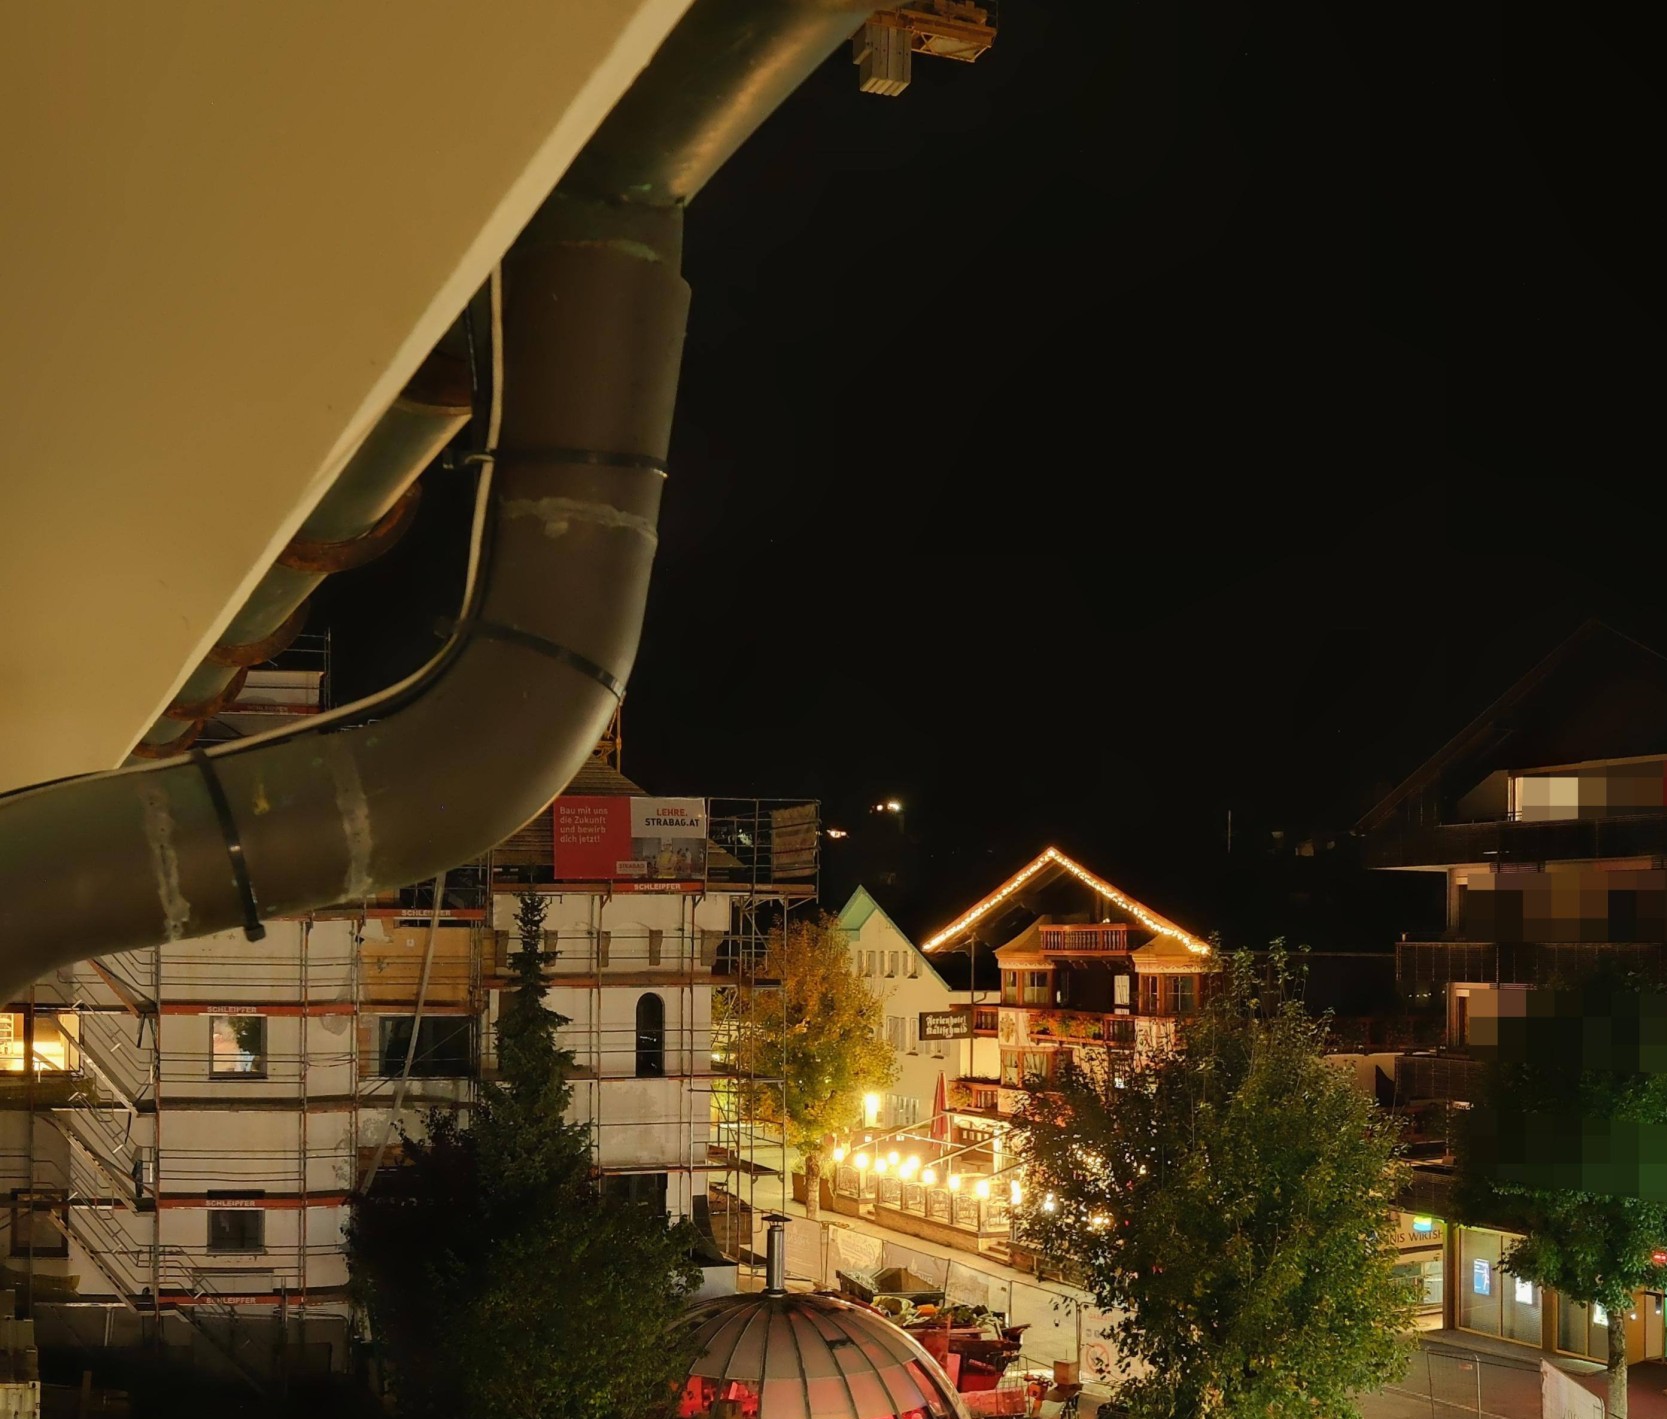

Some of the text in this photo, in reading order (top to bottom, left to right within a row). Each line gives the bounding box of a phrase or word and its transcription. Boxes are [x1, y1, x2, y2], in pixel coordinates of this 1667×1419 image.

[578, 807, 591, 815] mit
[657, 808, 687, 817] LEHRE.
[575, 817, 606, 825] Zukunft
[645, 818, 699, 828] STRABAG.AT
[633, 883, 681, 891] SCHLEIPFER
[207, 1006, 257, 1014] SCHLEIPFER
[205, 1199, 256, 1207] SCHLEIPFER
